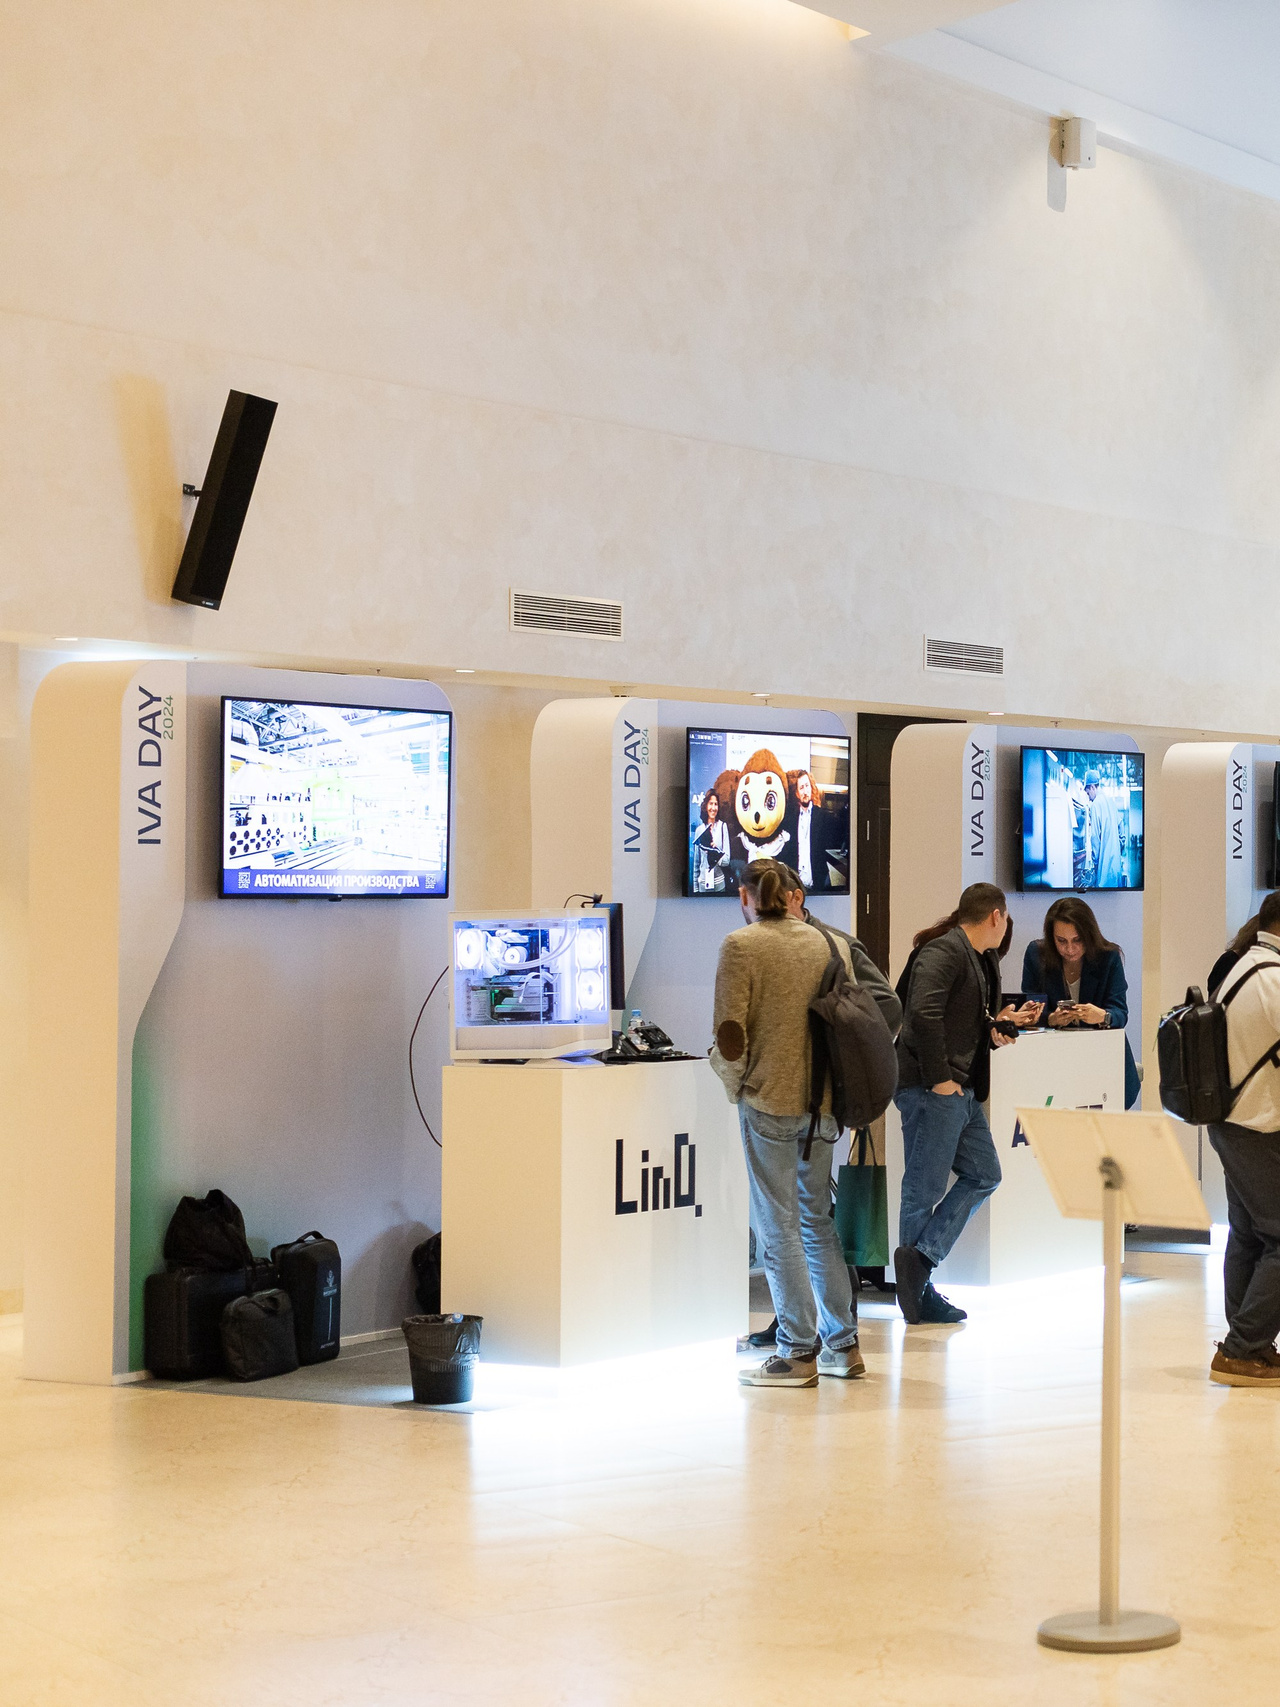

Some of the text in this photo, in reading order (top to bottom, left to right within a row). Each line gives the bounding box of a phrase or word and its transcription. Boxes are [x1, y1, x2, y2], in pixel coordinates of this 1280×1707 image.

[163, 695, 174, 740] 2024
[641, 728, 649, 765] 2024
[138, 686, 161, 844] IVA DAY
[624, 720, 640, 852] IVA DAY
[971, 742, 984, 856] IVA DAY
[1233, 759, 1242, 859] IVA DAY
[254, 873, 419, 889] АВТОМАТИЗАЦИЯ ПРОИЗВОДСТВА
[615, 1133, 702, 1217] LinQ
